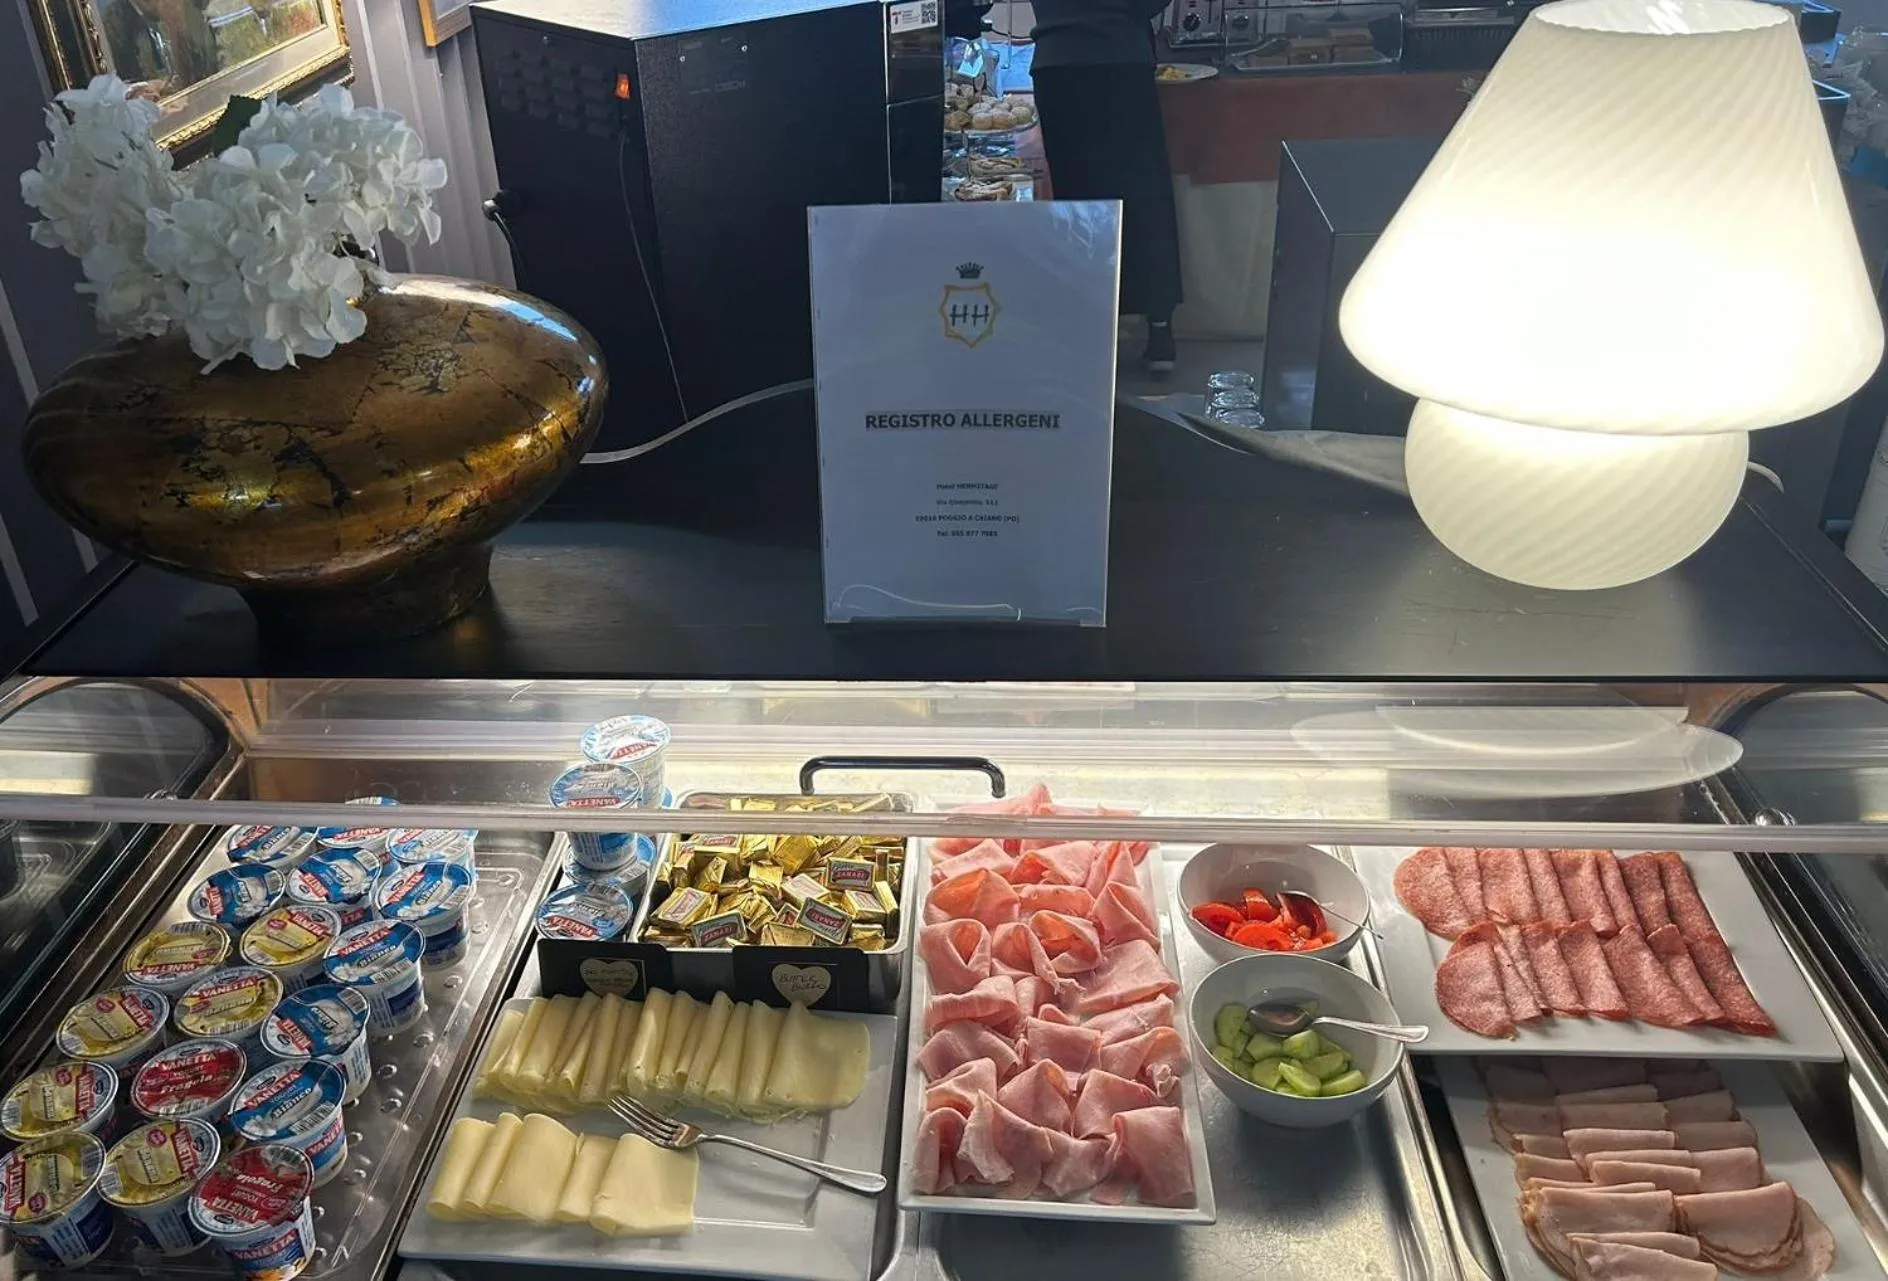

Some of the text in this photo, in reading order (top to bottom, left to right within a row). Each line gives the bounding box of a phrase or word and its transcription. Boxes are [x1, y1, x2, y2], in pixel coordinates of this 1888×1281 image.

[865, 412, 1061, 429] REGISTRO ALLERGENI
[338, 928, 392, 957] VANETTA
[202, 978, 258, 998] VANETTA
[161, 1052, 217, 1071] VANETTA
[245, 1070, 302, 1109] VANETTA
[271, 1087, 313, 1119] Bianco
[174, 1129, 194, 1175] VANETTA
[211, 1197, 259, 1223] VANETTA
